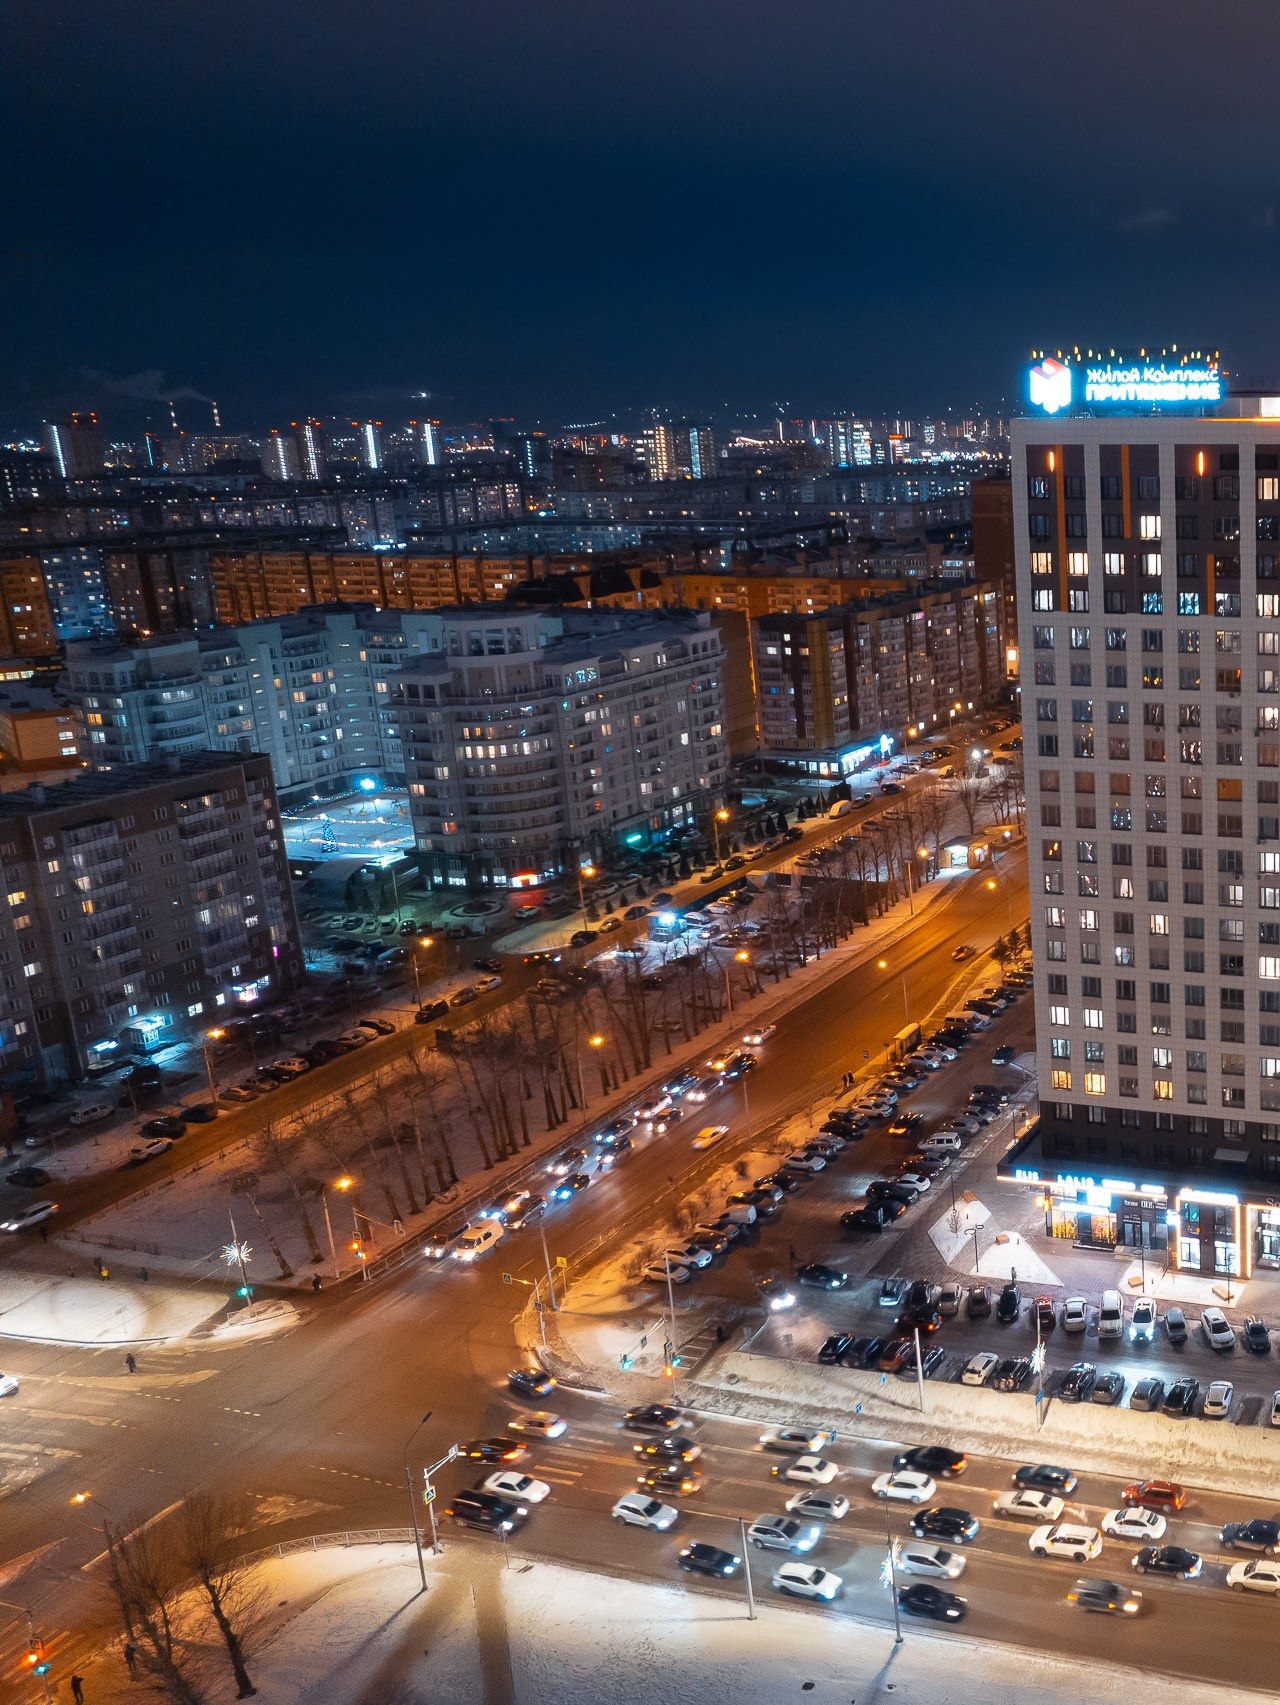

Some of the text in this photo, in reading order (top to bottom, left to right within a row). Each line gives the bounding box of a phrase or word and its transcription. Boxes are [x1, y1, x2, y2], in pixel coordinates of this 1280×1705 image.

[1087, 368, 1219, 383] Жилой Комплекс
[1086, 383, 1220, 401] ПРИТЯЖЕНИЕ
